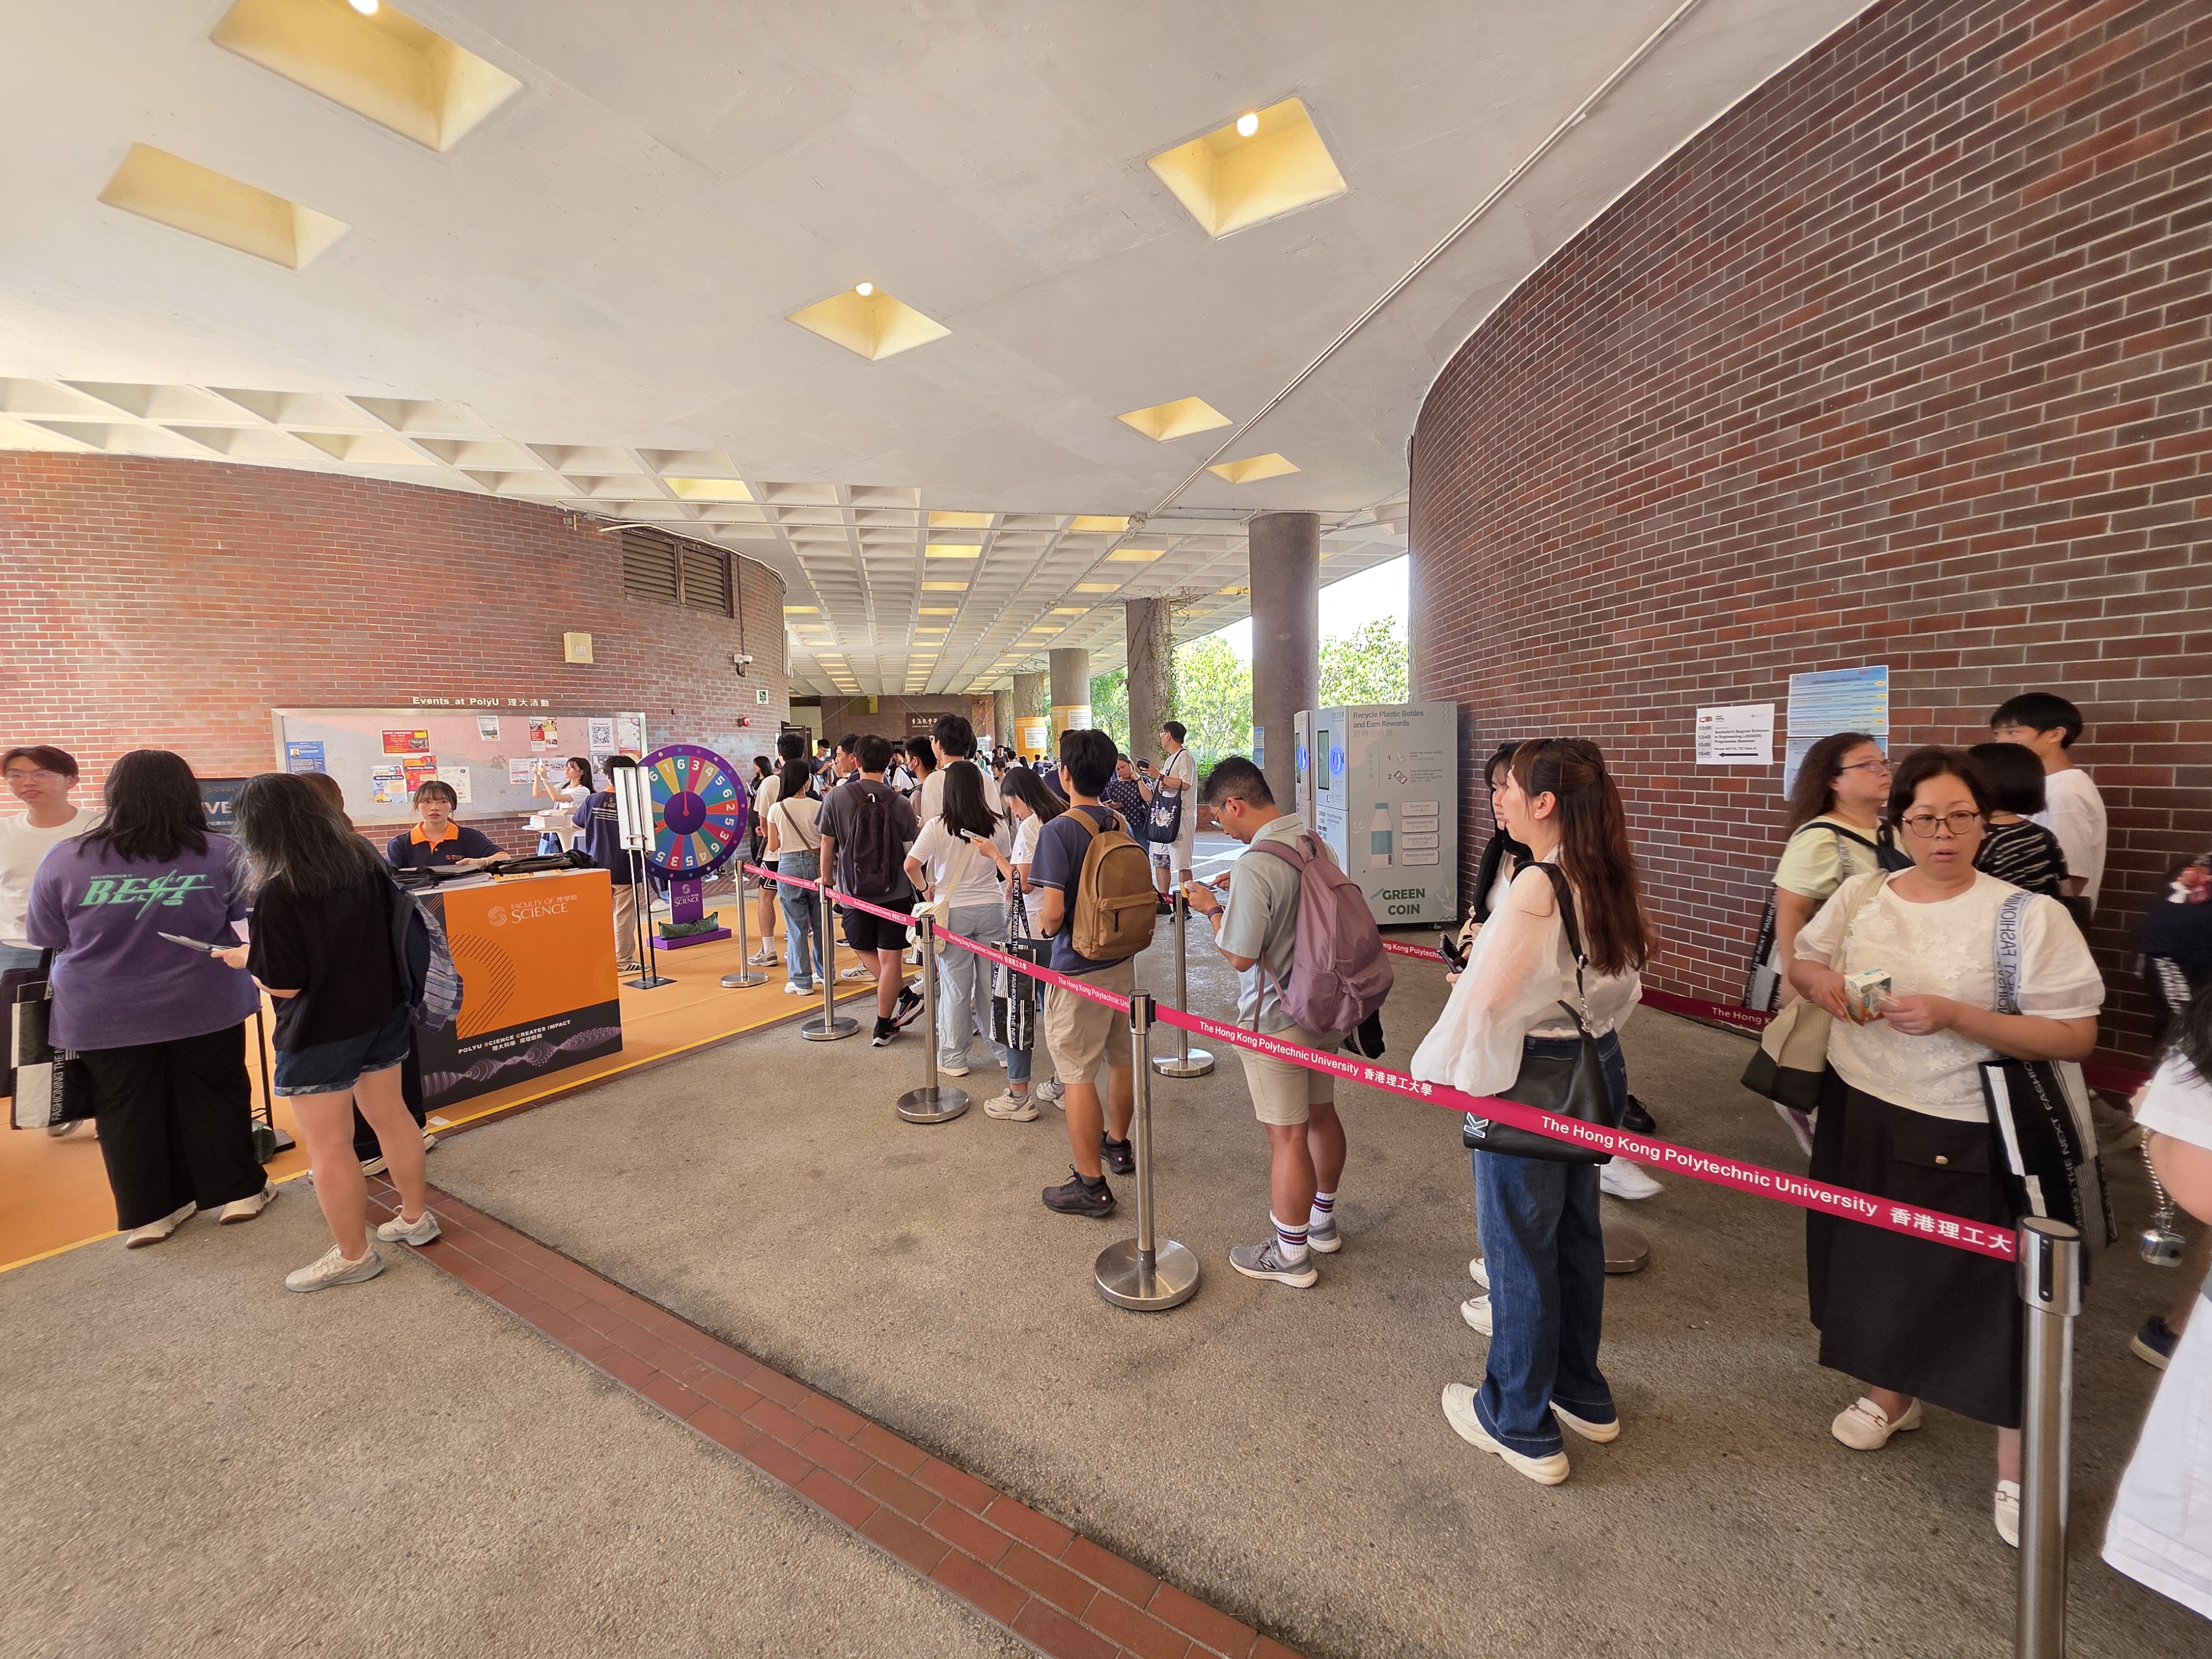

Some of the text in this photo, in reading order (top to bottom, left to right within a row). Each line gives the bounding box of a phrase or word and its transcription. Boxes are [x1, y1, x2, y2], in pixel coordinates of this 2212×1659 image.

[413, 696, 450, 705] Events
[470, 698, 499, 707] PolyU
[508, 698, 549, 707] 理大活動
[662, 762, 670, 773] 1
[677, 759, 685, 769] 6
[692, 760, 700, 770] 3
[705, 766, 713, 776] 4
[715, 775, 726, 785] 5
[723, 789, 732, 798] 6
[725, 817, 734, 826] 5
[719, 831, 729, 841] 3
[655, 851, 666, 863] 5
[671, 857, 679, 867] 3
[686, 855, 693, 866] 5
[699, 852, 707, 862] 4
[79, 872, 209, 907] BEST
[1383, 888, 1426, 900] GREEN
[511, 900, 542, 910] FACULTY
[557, 894, 578, 902] 理學院
[674, 897, 699, 907] SCIENCE
[512, 902, 568, 924] SCIENCE
[1387, 904, 1420, 915] COIN
[1392, 943, 1408, 953] Kong
[987, 948, 1003, 961] University
[1058, 976, 1066, 984] The
[1067, 979, 1079, 992] Hong
[1079, 984, 1091, 996] Kong
[1092, 988, 1120, 1005] Polytechnic
[1712, 1006, 1731, 1017] The
[1733, 1011, 1762, 1025] Hong
[458, 1020, 571, 1054] POLYU SCIENCE CREATES IMPACT
[492, 1041, 516, 1051] 理大科學
[1199, 1021, 1433, 1097] The Hong Kong Polytechnic University 香港理工大學
[52, 1053, 65, 1121] FASHIONING THE
[2051, 1117, 2070, 1156] NEXT
[2064, 1158, 2075, 1186] THE
[1541, 1115, 2012, 1253] The Hong Kong Polytechnic University 香港理工大
